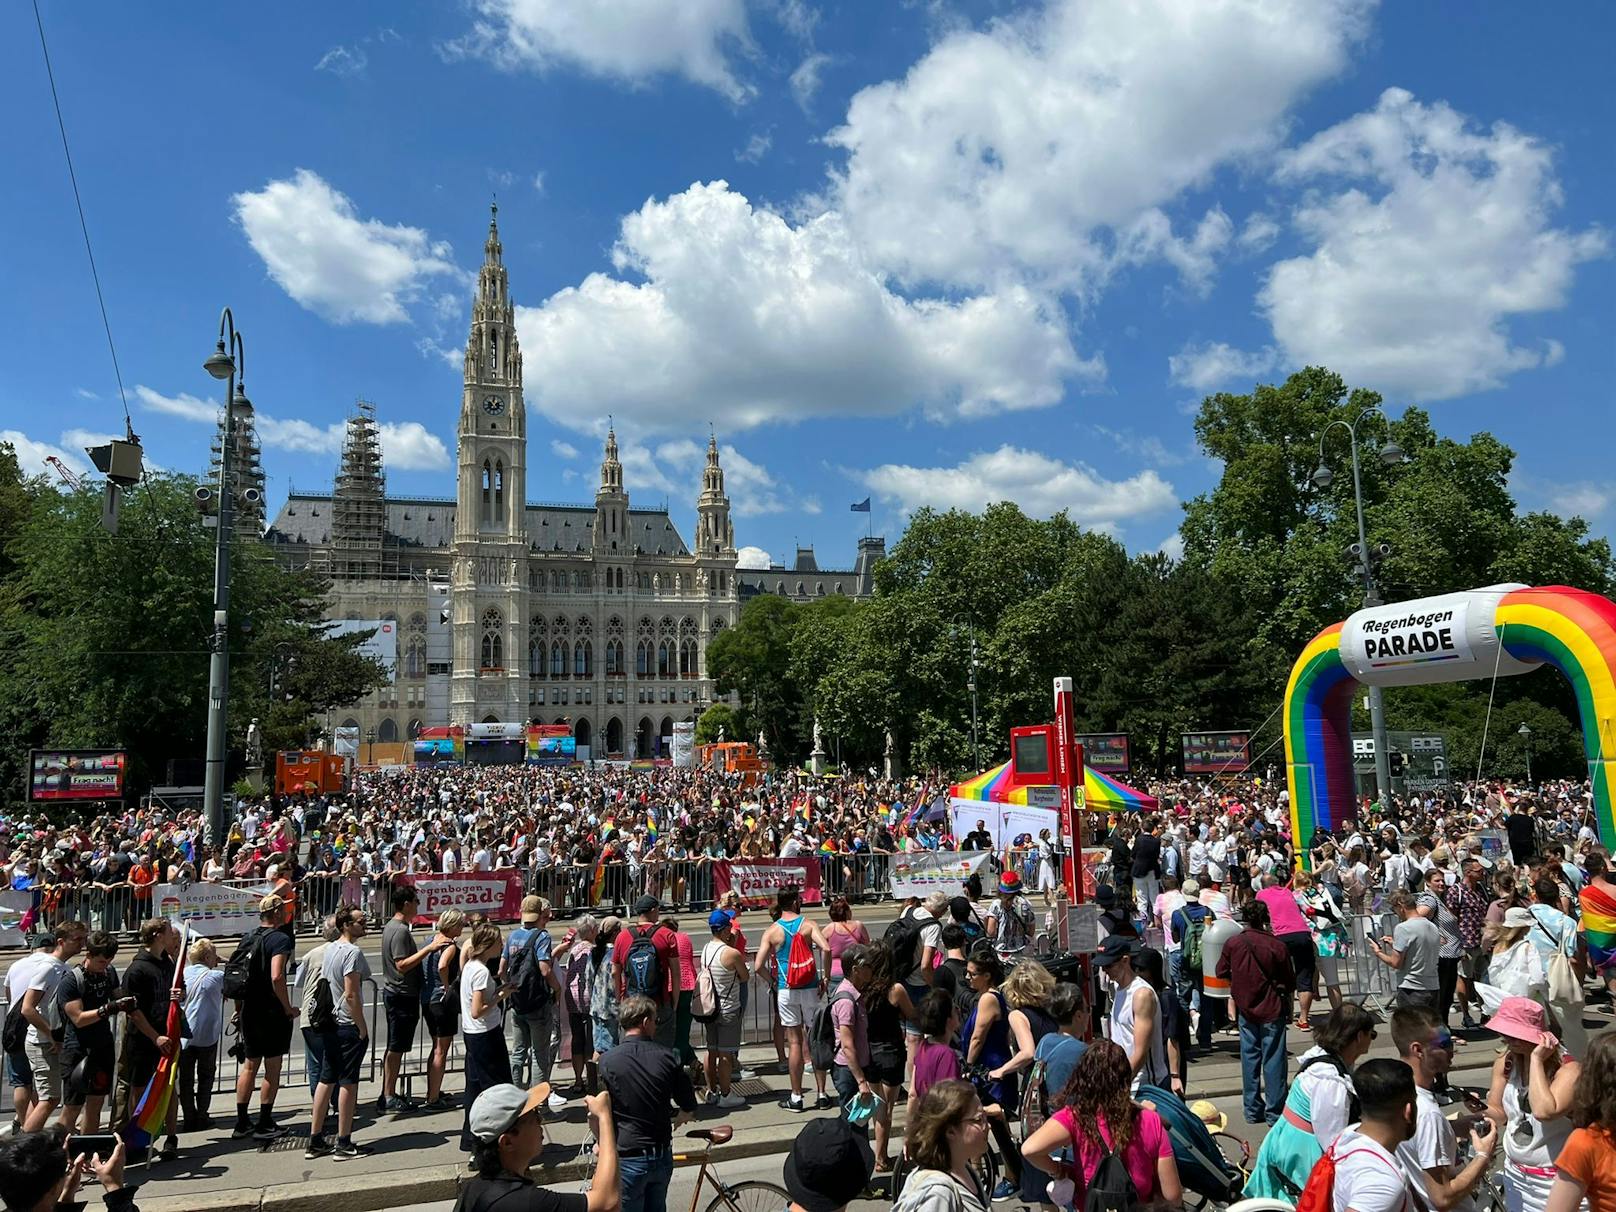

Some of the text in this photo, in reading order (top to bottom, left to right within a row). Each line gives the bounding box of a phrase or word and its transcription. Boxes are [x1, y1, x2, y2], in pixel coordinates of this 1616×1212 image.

[1362, 610, 1453, 635] Regenbogen
[1364, 627, 1455, 659] PARADE
[1353, 739, 1376, 754] BO
[416, 884, 483, 896] regenbogen
[740, 872, 805, 895] parade
[186, 892, 248, 904] Regenbogen
[426, 887, 505, 912] parade
